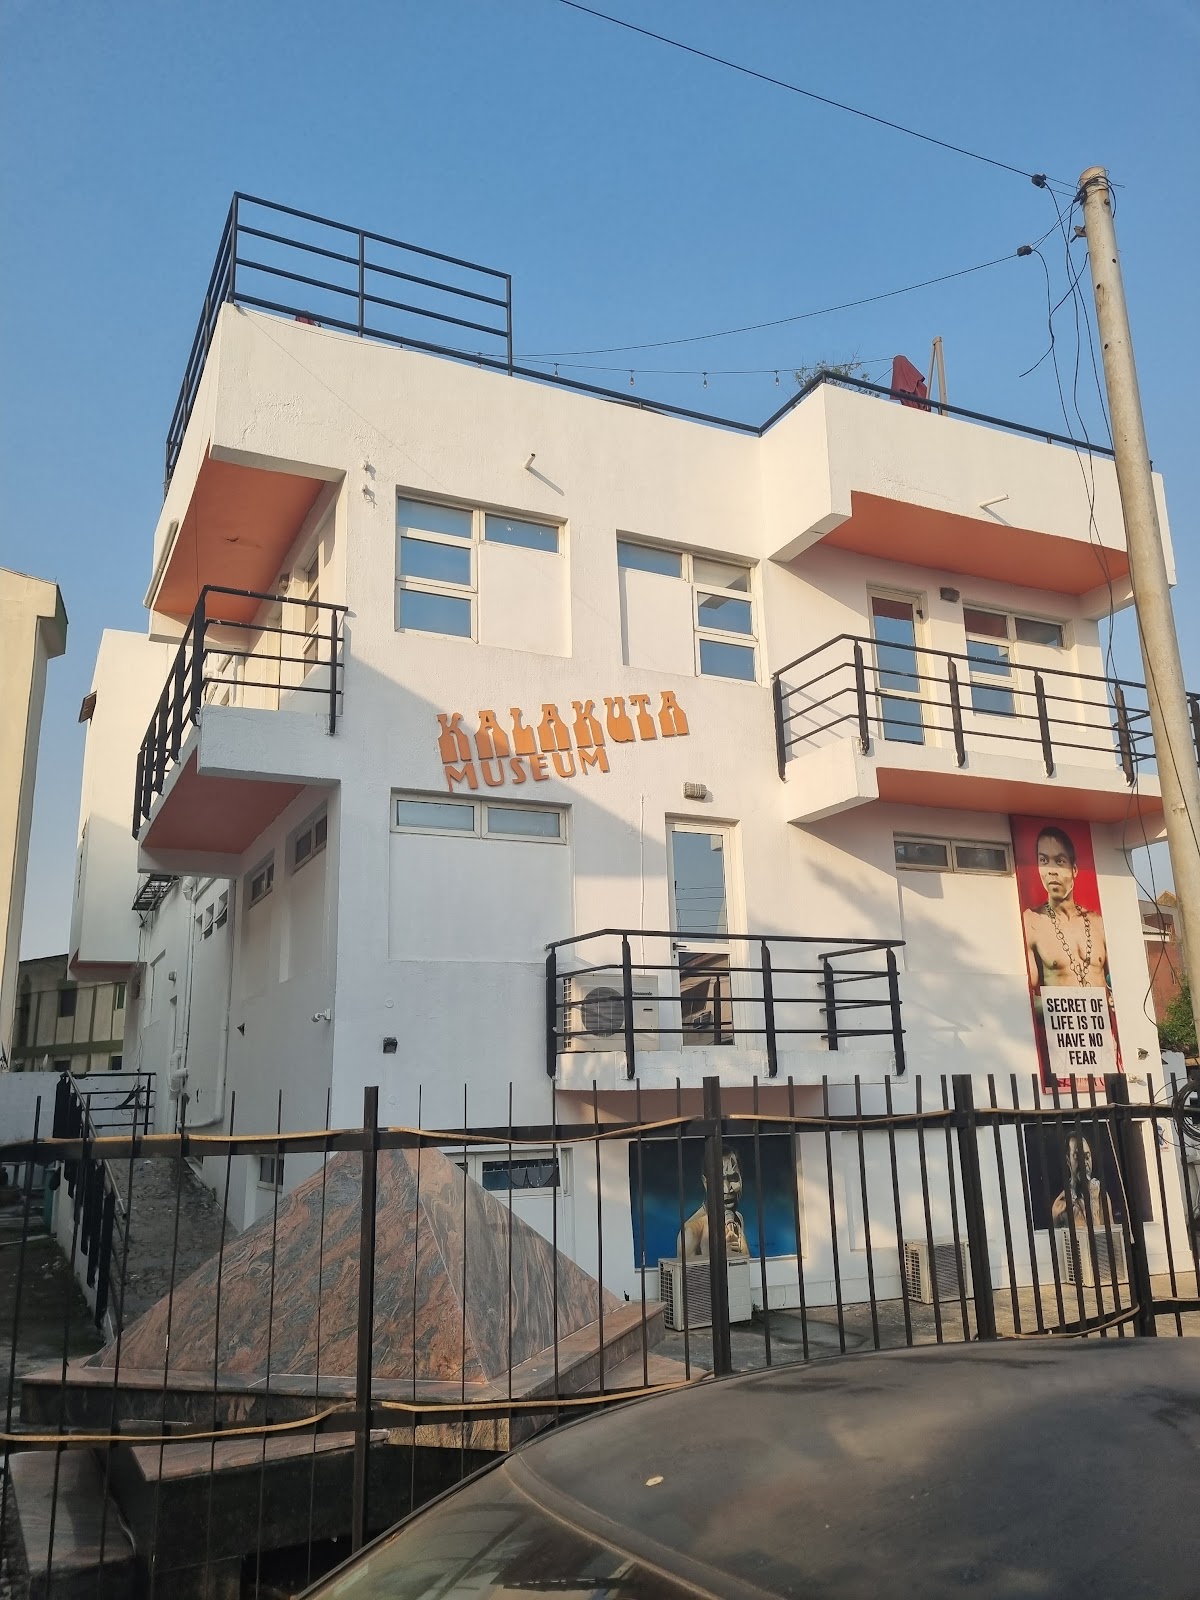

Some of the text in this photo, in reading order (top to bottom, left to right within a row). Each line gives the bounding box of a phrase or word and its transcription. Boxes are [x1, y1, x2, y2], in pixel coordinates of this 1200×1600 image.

[436, 691, 690, 763] KALAKUTA
[444, 747, 609, 793] MUSEUM
[1046, 998, 1103, 1012] SECRET OF
[1050, 1015, 1105, 1030] LIFE IS TO
[1057, 1032, 1104, 1047] HAVE NO
[1069, 1050, 1097, 1065] FEAR
